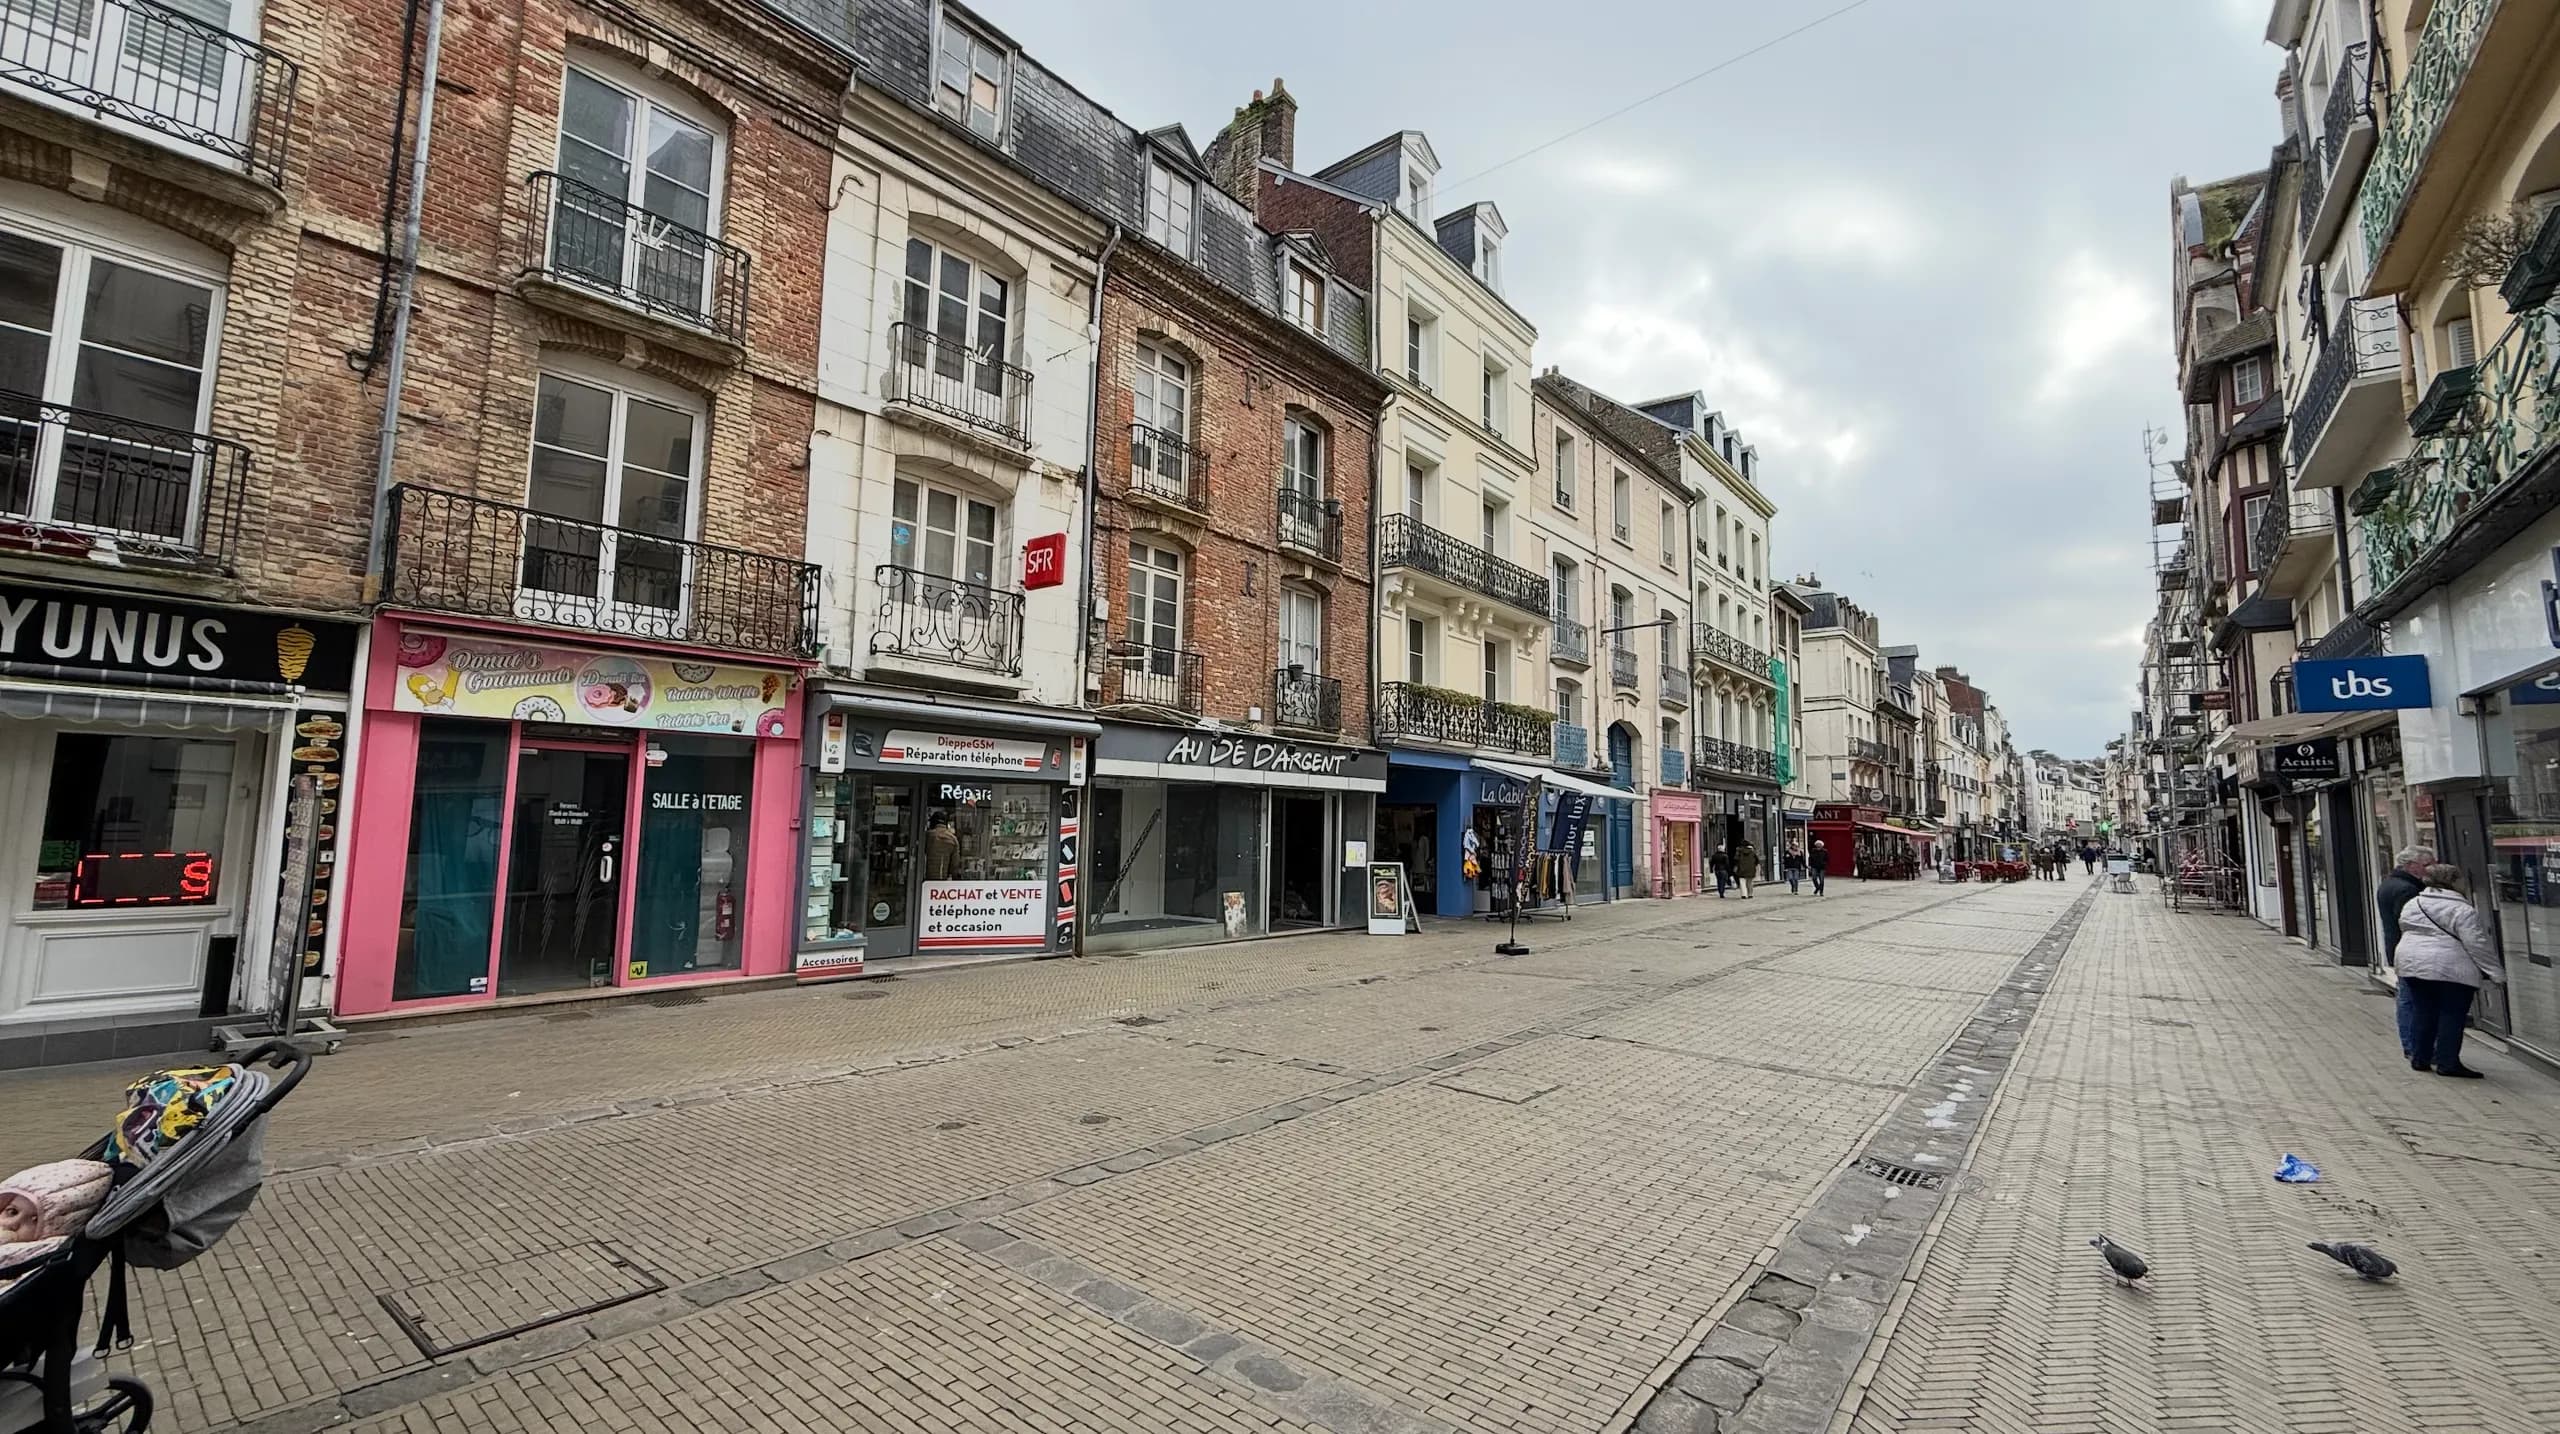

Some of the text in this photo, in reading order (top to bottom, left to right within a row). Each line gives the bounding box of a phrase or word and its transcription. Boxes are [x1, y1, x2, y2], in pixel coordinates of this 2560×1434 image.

[1027, 548, 1053, 573] SFR
[0, 599, 227, 671] YUNUS
[450, 649, 543, 672] Donut's
[467, 667, 575, 693] Gourmands
[2331, 669, 2393, 699] tbs
[665, 685, 760, 702] Bubble Waffle
[656, 712, 704, 728] Bubble
[937, 735, 995, 750] DieppeGSM
[906, 746, 1023, 767] Réparation téléphone
[1167, 736, 1347, 774] AU DÉ D'ARGENT
[2281, 756, 2334, 767] Acuitis
[652, 792, 690, 810] SALLE
[692, 793, 700, 809] à
[1481, 782, 1496, 802] La
[1568, 796, 1586, 820] lux
[1816, 810, 1840, 820] ANT
[930, 888, 1042, 900] RACHAT et VENTE
[929, 904, 1029, 917] téléphone neuf
[928, 922, 1002, 933] et occasion
[802, 954, 859, 967] Accessoires
